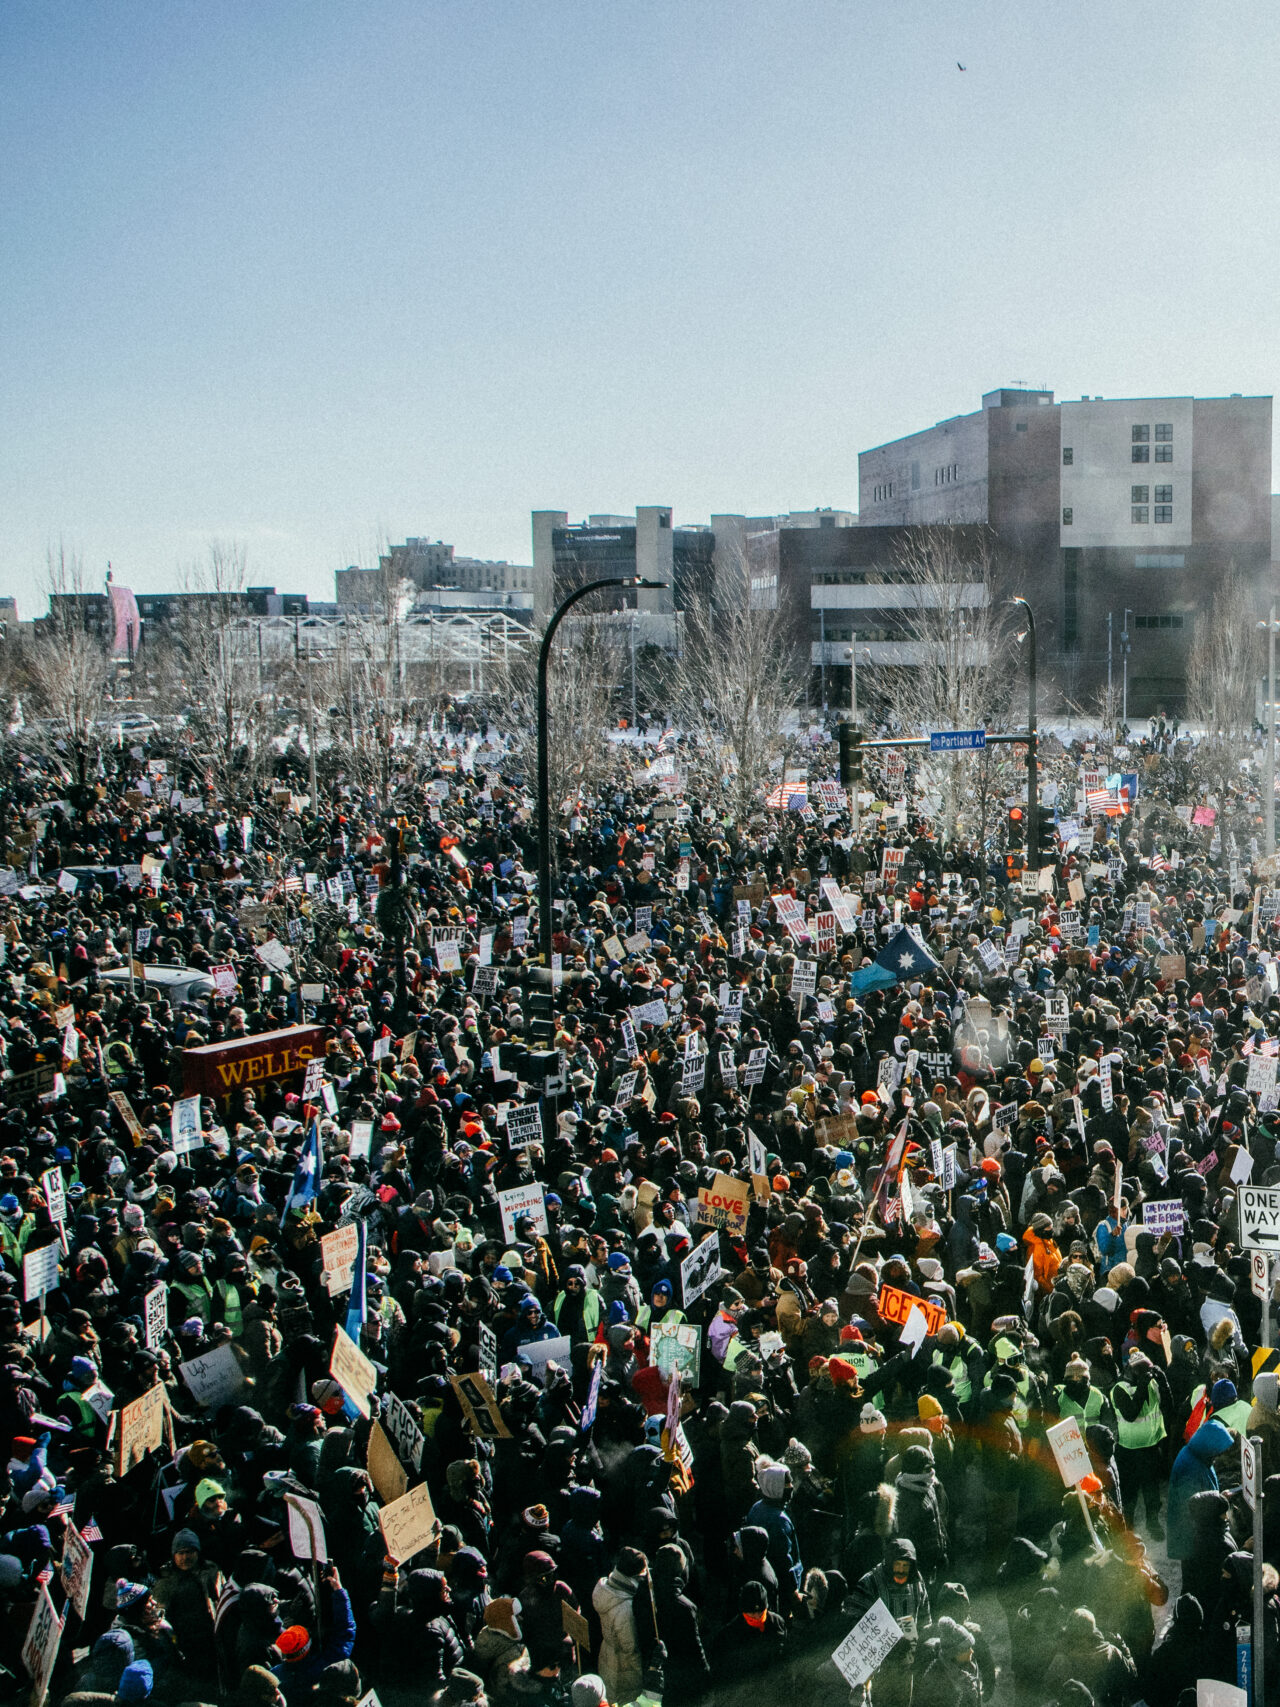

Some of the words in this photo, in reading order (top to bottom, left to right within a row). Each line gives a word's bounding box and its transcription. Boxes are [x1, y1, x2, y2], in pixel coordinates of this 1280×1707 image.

[941, 734, 972, 748] Portland
[974, 734, 984, 746] Av
[1084, 774, 1098, 783] NO
[825, 795, 838, 803] NO
[886, 852, 904, 863] NO
[1108, 859, 1121, 869] STOP
[1110, 870, 1119, 880] ICE
[827, 886, 841, 900] NO
[777, 898, 795, 913] NO
[784, 908, 800, 918] KINGS
[835, 907, 850, 919] NO
[1061, 912, 1079, 924] STOP
[790, 918, 807, 933] NO
[818, 914, 834, 929] NO
[433, 928, 466, 945] NOPE!
[818, 928, 835, 938] KINGS
[818, 938, 836, 952] NO
[979, 940, 992, 956] STOP
[728, 991, 739, 1006] ICE
[821, 1010, 832, 1018] OUT
[1050, 1002, 1064, 1016] ICE
[1038, 1040, 1053, 1054] STOP
[684, 1055, 705, 1074] STOP
[721, 1054, 732, 1069] ICE
[880, 1059, 893, 1070] ICE
[920, 1052, 952, 1065] FUCK
[217, 1045, 314, 1087] WELLS
[308, 1061, 325, 1075] ICE
[622, 1073, 635, 1084] ICE
[1249, 1070, 1275, 1081] JACK
[304, 1079, 323, 1093] OUT
[682, 1080, 704, 1089] NOW!
[1249, 1080, 1274, 1091] SMITH
[617, 1090, 633, 1104] MPLS
[507, 1106, 540, 1119] GENERAL
[996, 1105, 1017, 1117] GENERAL
[996, 1113, 1017, 1128] STRIKE
[510, 1126, 520, 1135] THE
[521, 1125, 533, 1134] PATH
[534, 1124, 542, 1132] TO
[512, 1133, 542, 1145] JUSTICE
[1146, 1133, 1161, 1146] ICE
[1153, 1141, 1162, 1150] UT
[50, 1170, 60, 1191] ICE
[504, 1192, 525, 1202] Lying
[704, 1191, 743, 1215] LOVE
[1244, 1192, 1279, 1208] ONE
[504, 1198, 542, 1214] MURDERING
[715, 1206, 730, 1219] THY
[1146, 1204, 1157, 1213] ONE
[1158, 1204, 1169, 1212] DAY
[514, 1207, 532, 1220] ICE
[1144, 1215, 1158, 1225] HAVE
[1158, 1214, 1165, 1223] TO
[1244, 1210, 1279, 1226] WAY
[698, 1210, 742, 1232] NEIGHBOR
[1148, 1226, 1163, 1234] YOUR
[684, 1258, 695, 1272] WE
[700, 1238, 717, 1255] WILL
[705, 1269, 720, 1286] THEM
[149, 1290, 164, 1310] STAY
[883, 1286, 912, 1324] ICE
[148, 1304, 166, 1325] SALTY
[479, 1326, 496, 1353] ICE
[123, 1406, 142, 1426] FUCK
[143, 1392, 162, 1412] ICE
[391, 1398, 423, 1445] FUCK
[1056, 1430, 1080, 1449] LITERAL
[1064, 1450, 1084, 1464] NAZIS
[384, 1511, 398, 1530] GET
[401, 1504, 410, 1514] THE
[410, 1491, 426, 1510] FUCK
[393, 1520, 406, 1536] OUT
[858, 1628, 882, 1655] Hands
[870, 1634, 898, 1668] EGGROLLS
